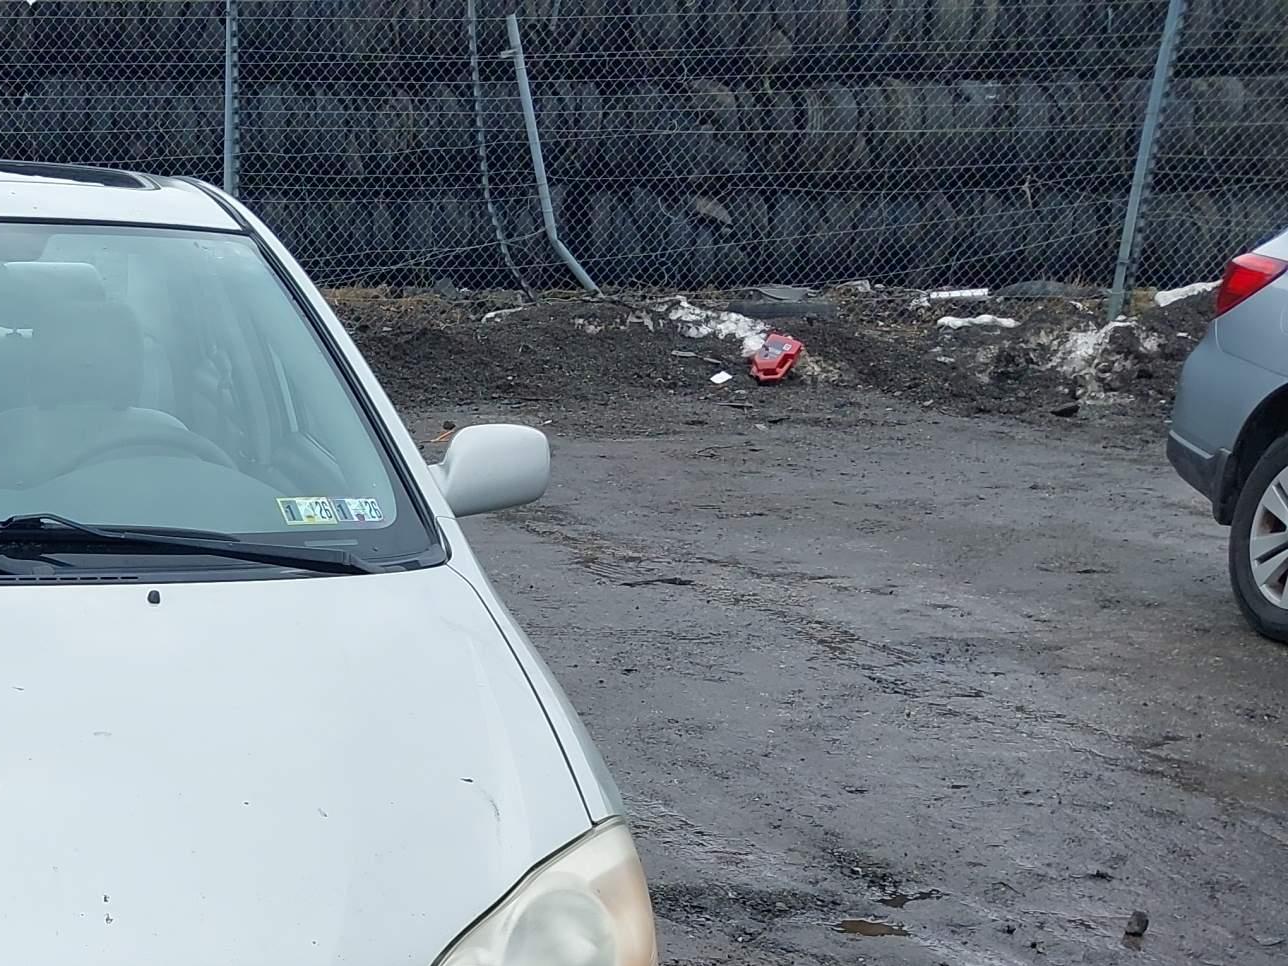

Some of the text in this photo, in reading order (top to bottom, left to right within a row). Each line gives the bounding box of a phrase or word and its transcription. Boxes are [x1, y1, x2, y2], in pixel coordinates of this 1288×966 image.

[285, 500, 333, 521] 1 26
[336, 500, 383, 520] 1 26
